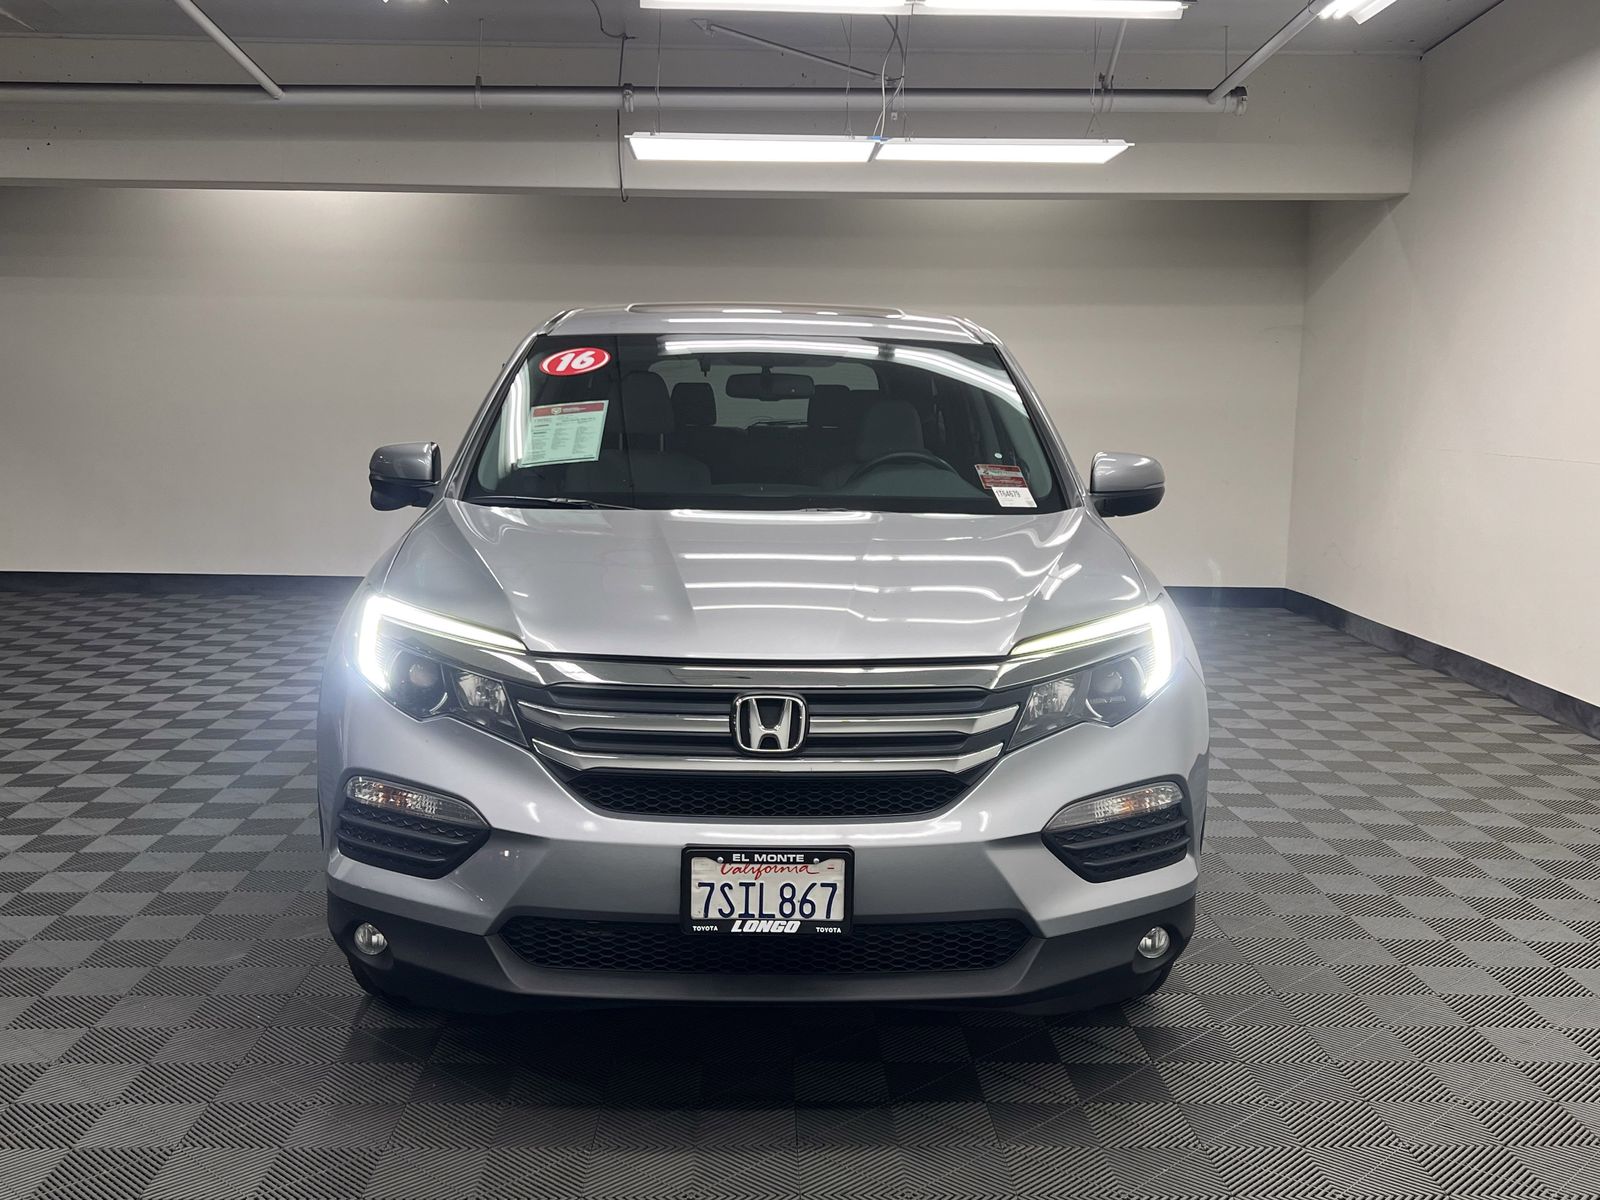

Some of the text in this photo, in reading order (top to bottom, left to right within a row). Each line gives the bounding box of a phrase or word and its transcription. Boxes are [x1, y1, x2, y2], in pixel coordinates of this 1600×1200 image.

[556, 351, 595, 371] 16
[732, 853, 805, 862] EL MONTE
[720, 863, 820, 880] California
[697, 881, 838, 919] 7SIL867
[731, 920, 801, 933] LONGO
